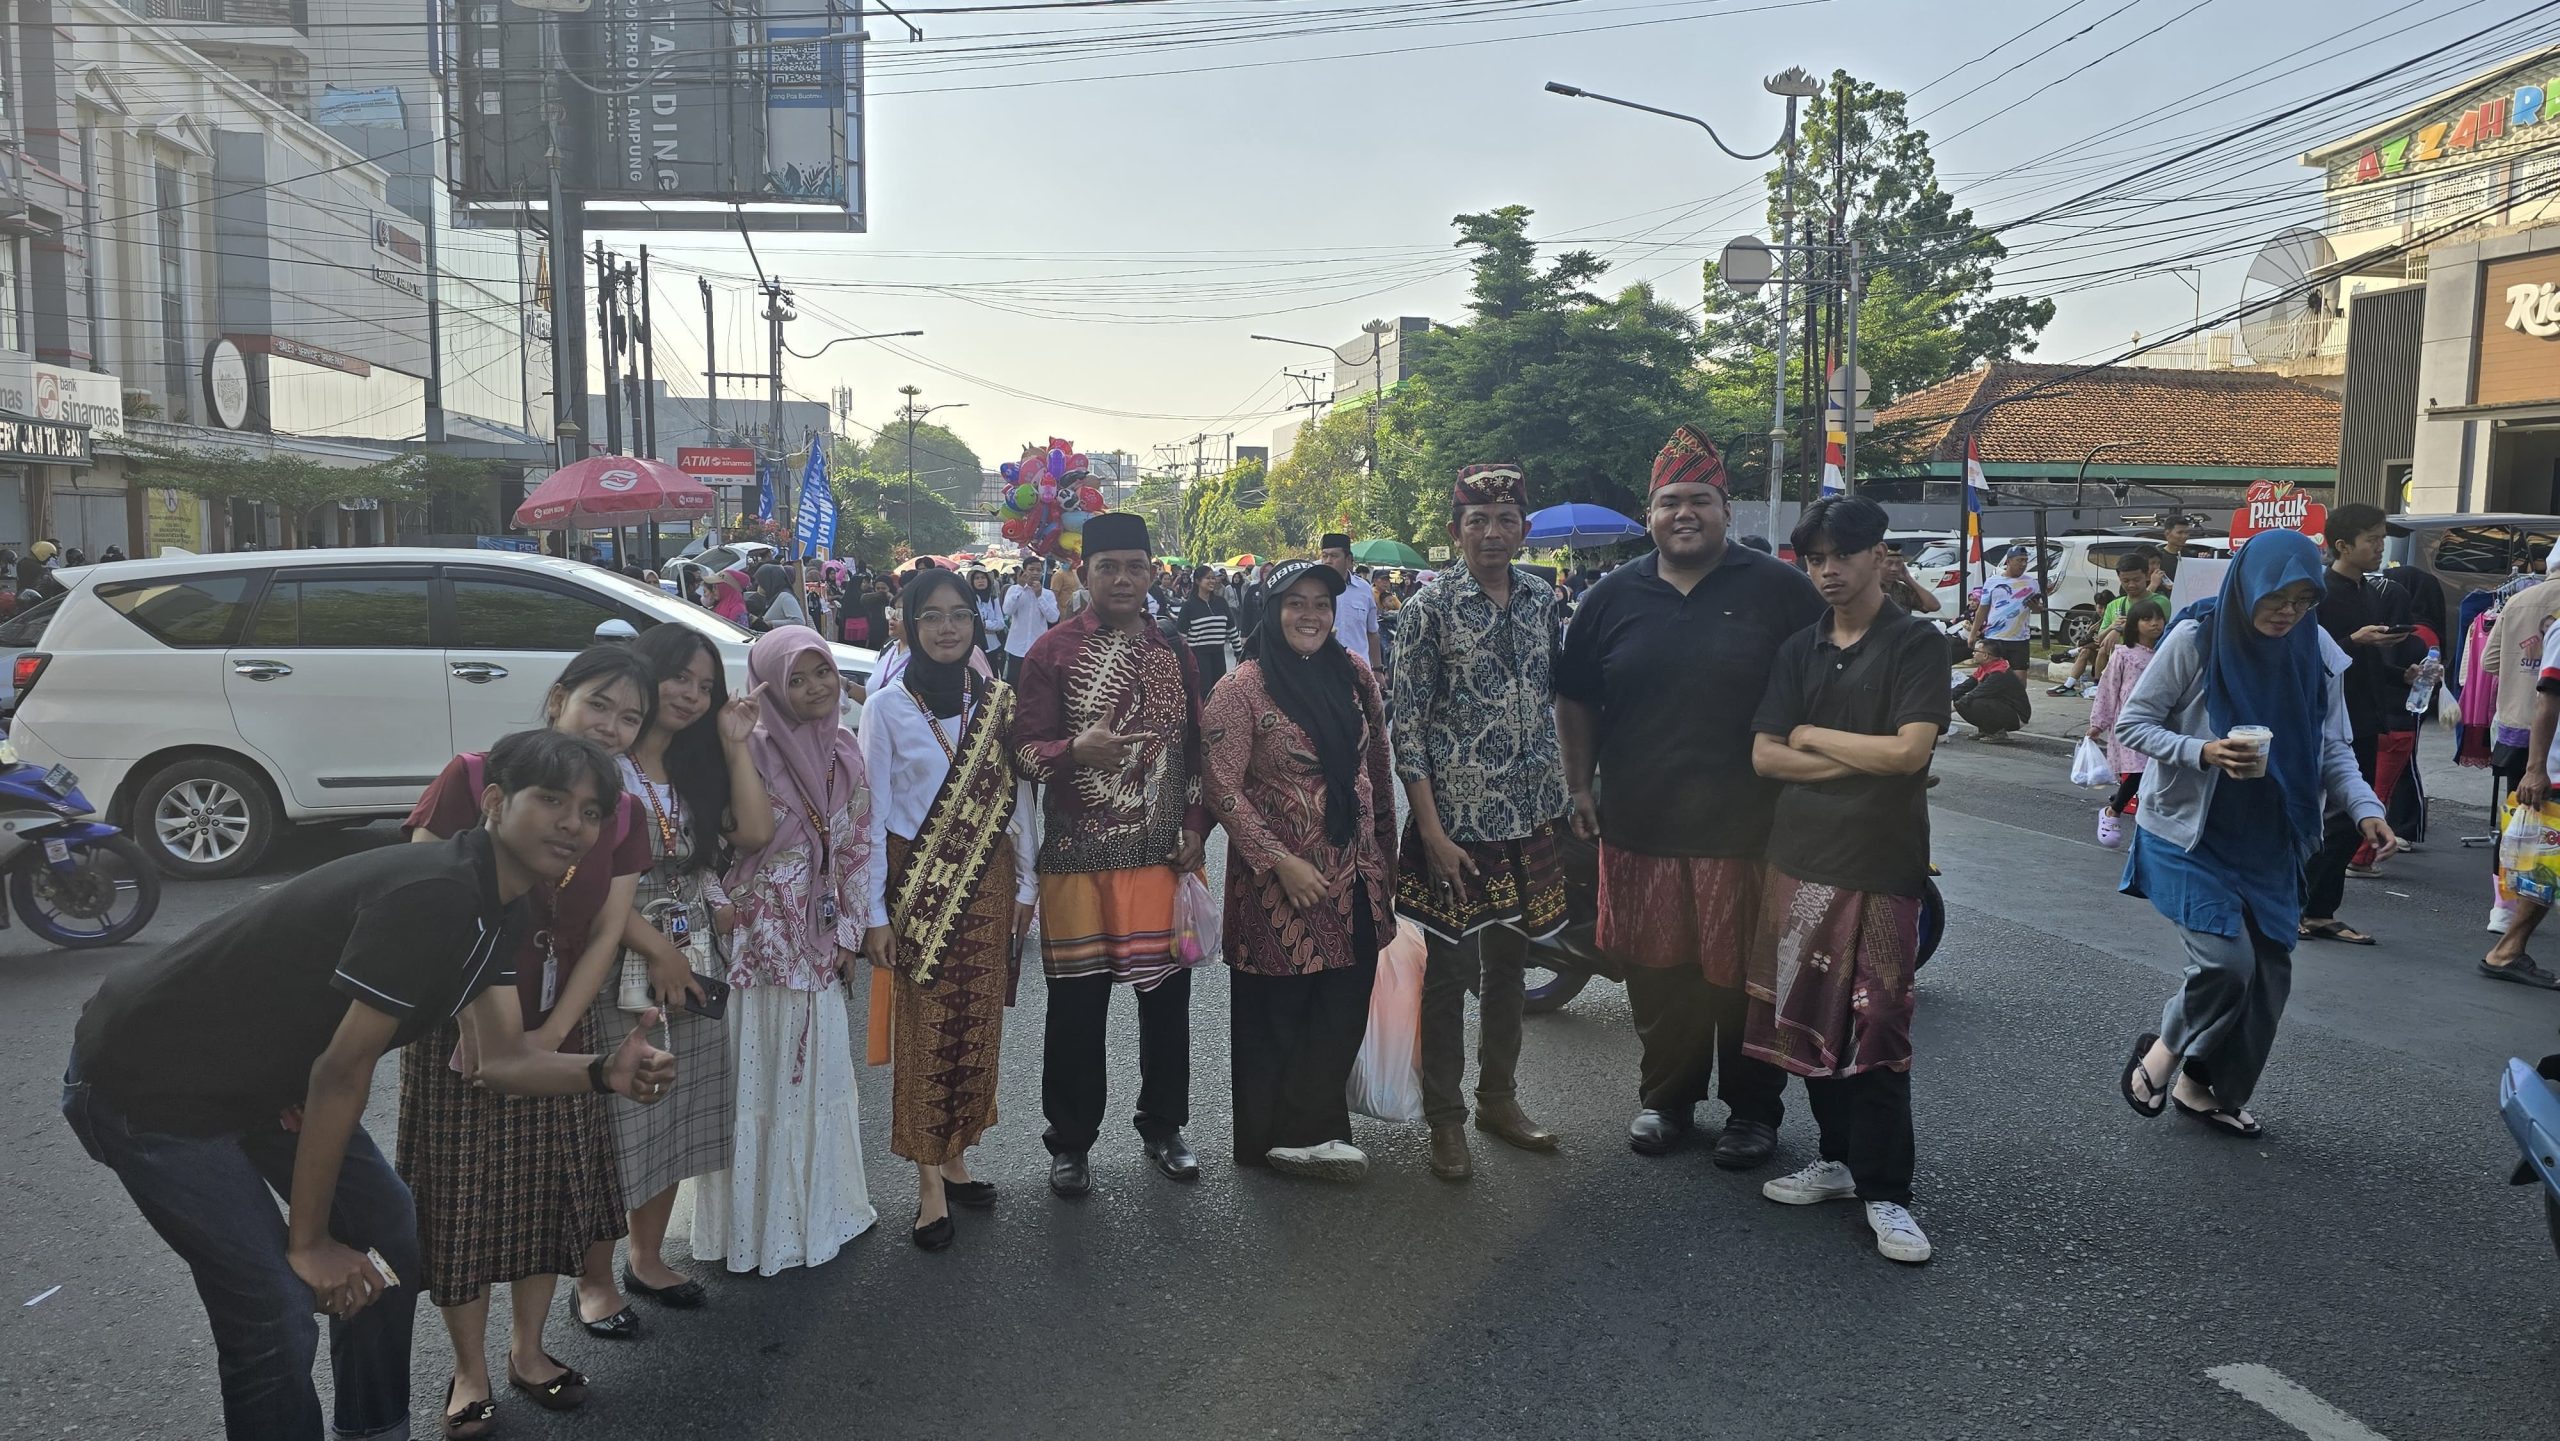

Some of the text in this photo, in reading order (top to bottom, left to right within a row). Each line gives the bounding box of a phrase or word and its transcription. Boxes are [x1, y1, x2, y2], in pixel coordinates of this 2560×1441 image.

[651, 0, 679, 191] TANDING
[627, 95, 642, 182] LAMPUNG
[60, 376, 77, 392] bank
[61, 394, 120, 427] sinarmas
[681, 455, 711, 467] ATM
[2248, 485, 2272, 502] Teh
[2249, 493, 2308, 529] pucuk
[2258, 516, 2302, 529] HARUM
[659, 817, 671, 840] KKN
[811, 814, 823, 834] KKN
[560, 865, 577, 888] KKN
